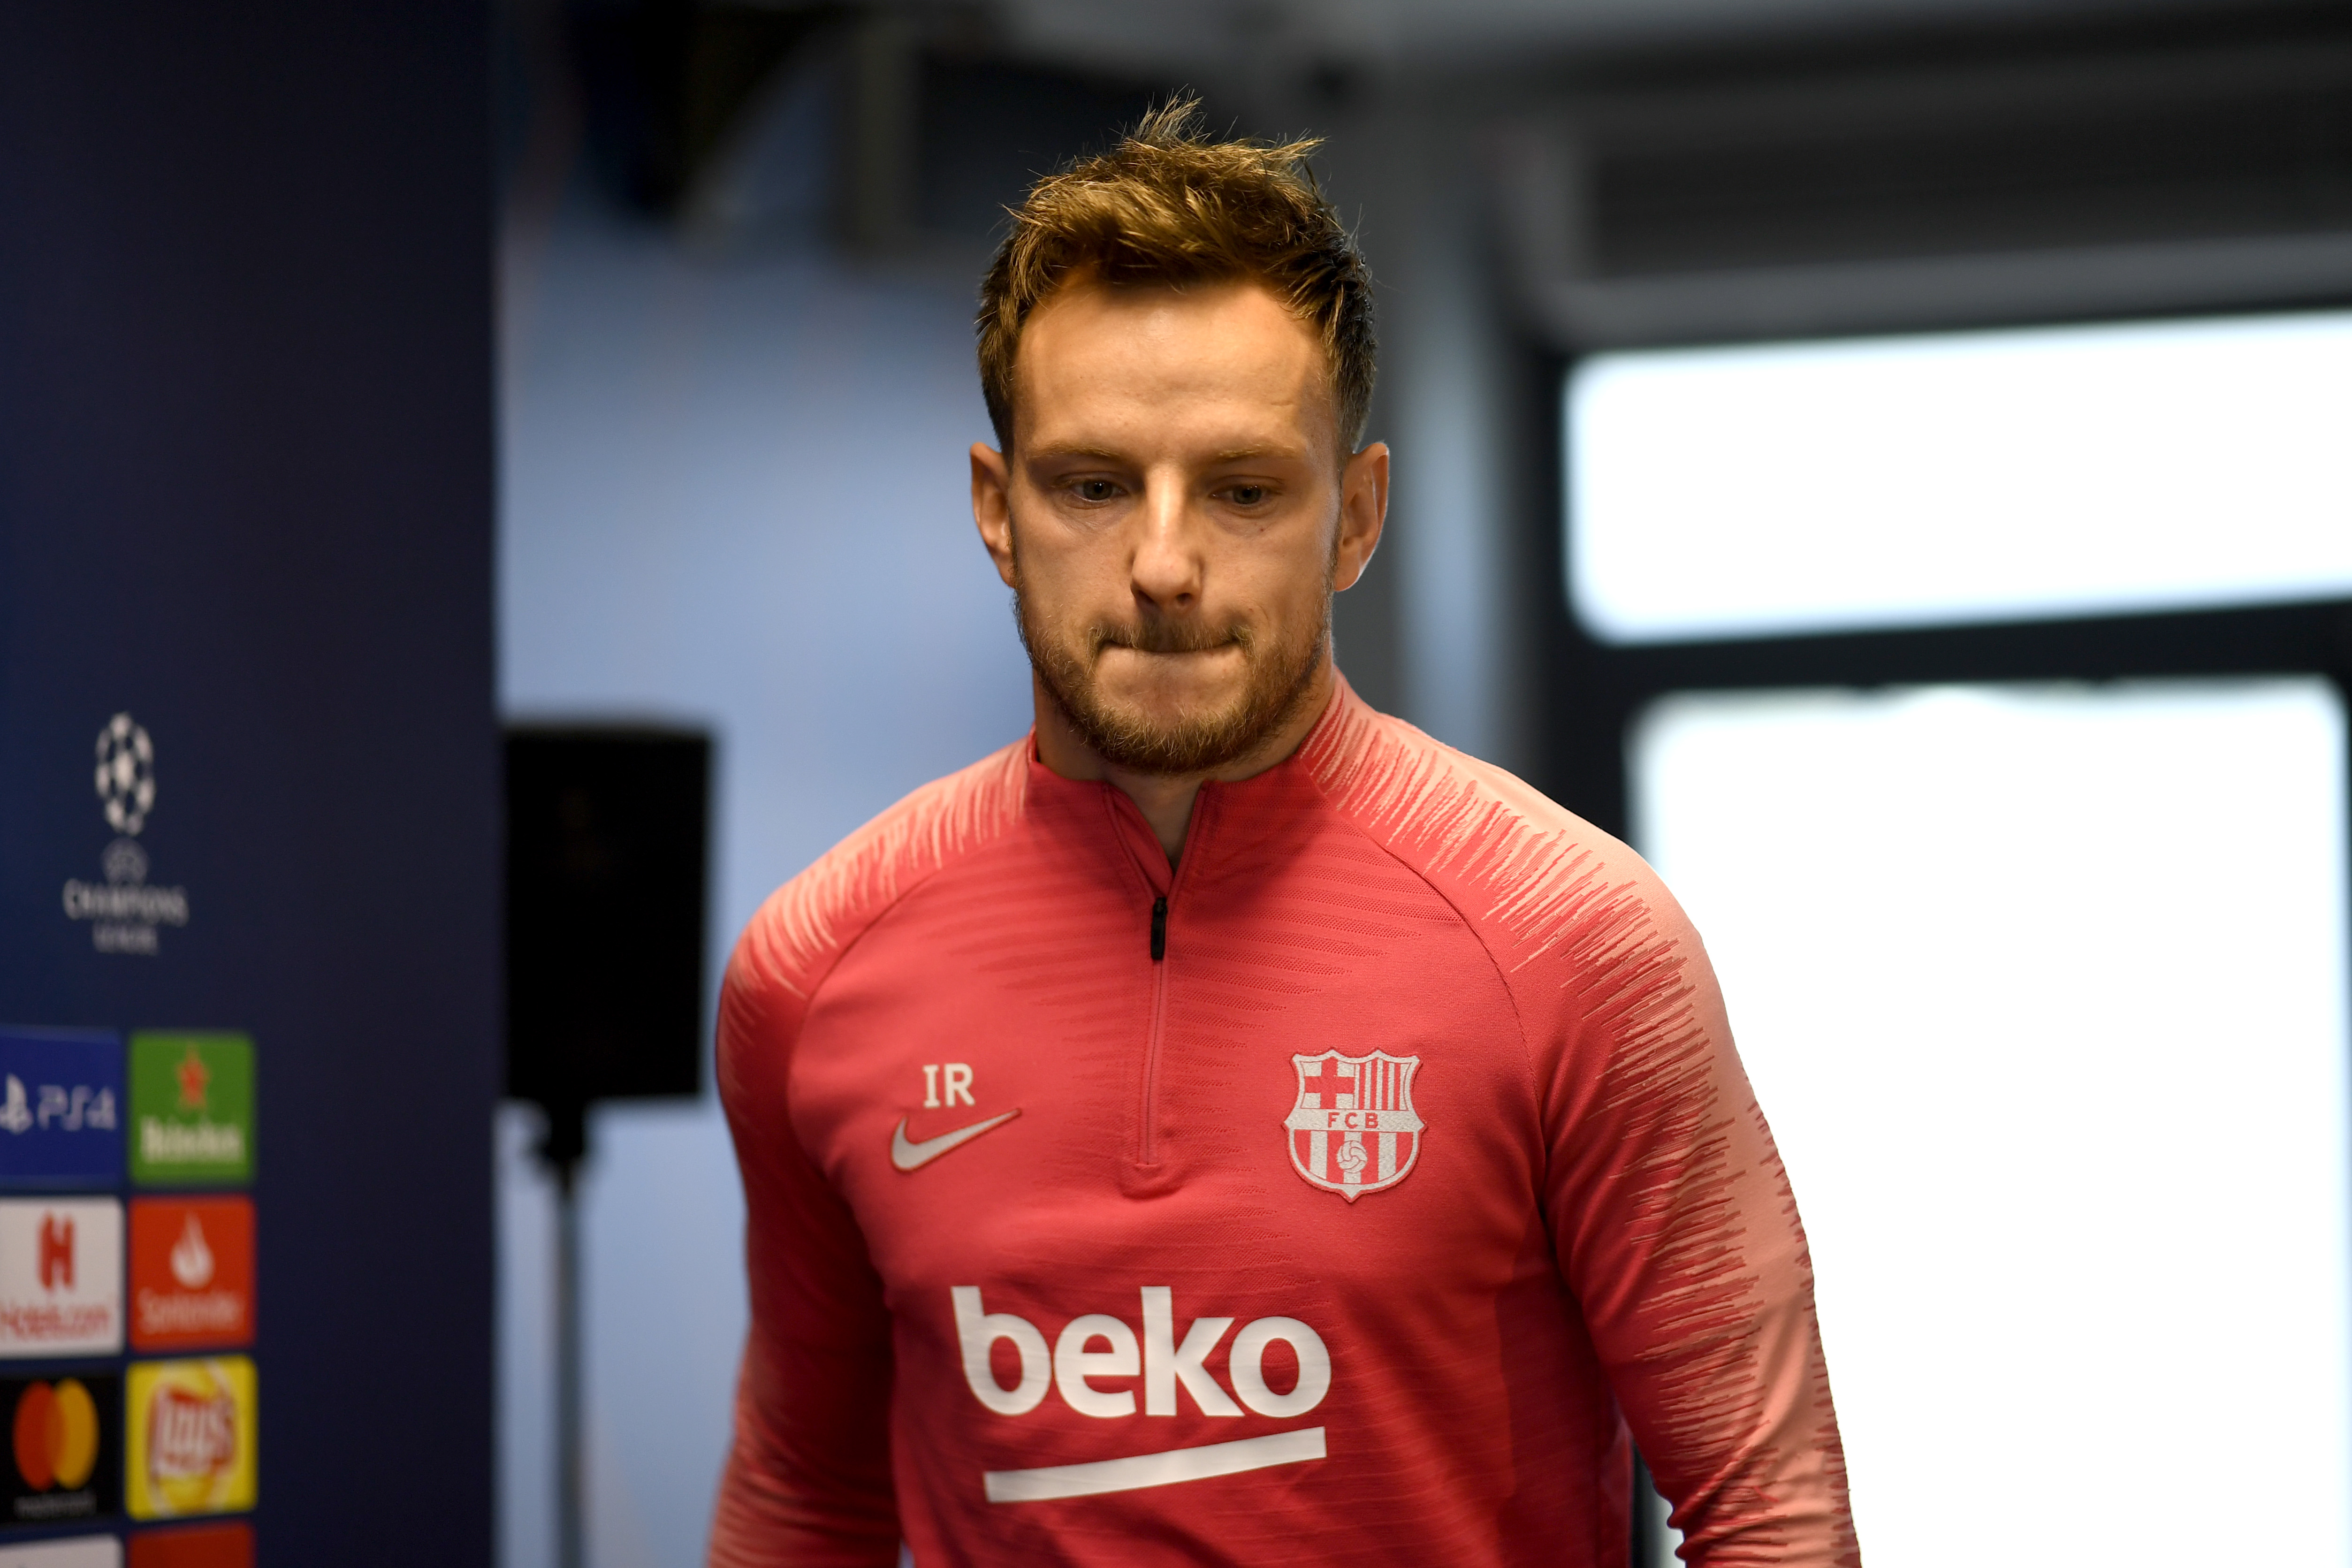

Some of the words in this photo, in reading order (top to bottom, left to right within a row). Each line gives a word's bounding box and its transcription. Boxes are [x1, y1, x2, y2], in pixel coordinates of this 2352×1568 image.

[38, 1084, 116, 1132] PS4
[923, 1063, 975, 1108] IR
[951, 1286, 1332, 1418] beko
